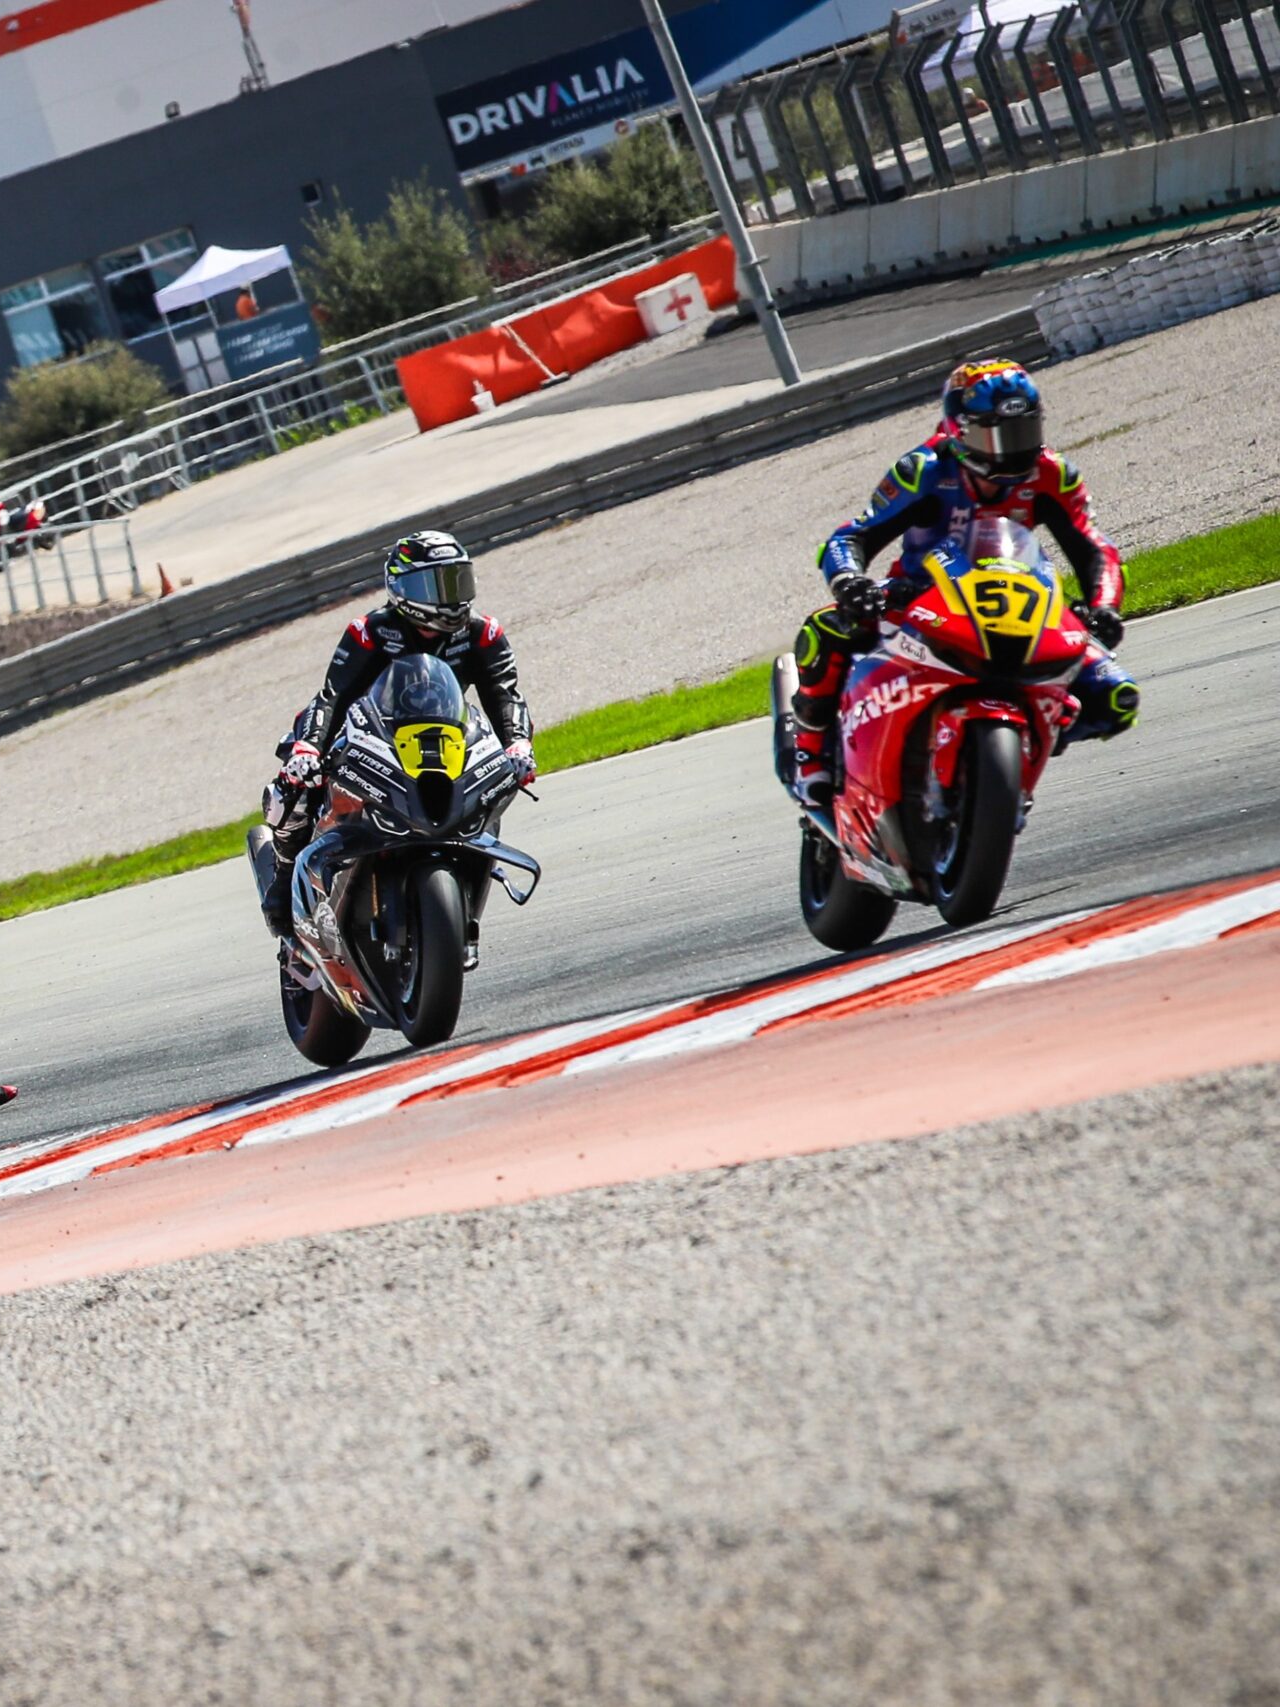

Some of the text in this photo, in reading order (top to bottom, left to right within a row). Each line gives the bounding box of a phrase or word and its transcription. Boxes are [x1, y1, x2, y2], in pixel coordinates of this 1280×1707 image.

[447, 57, 645, 145] DRIVALIA
[974, 579, 1040, 623] 57
[414, 726, 448, 770] 1
